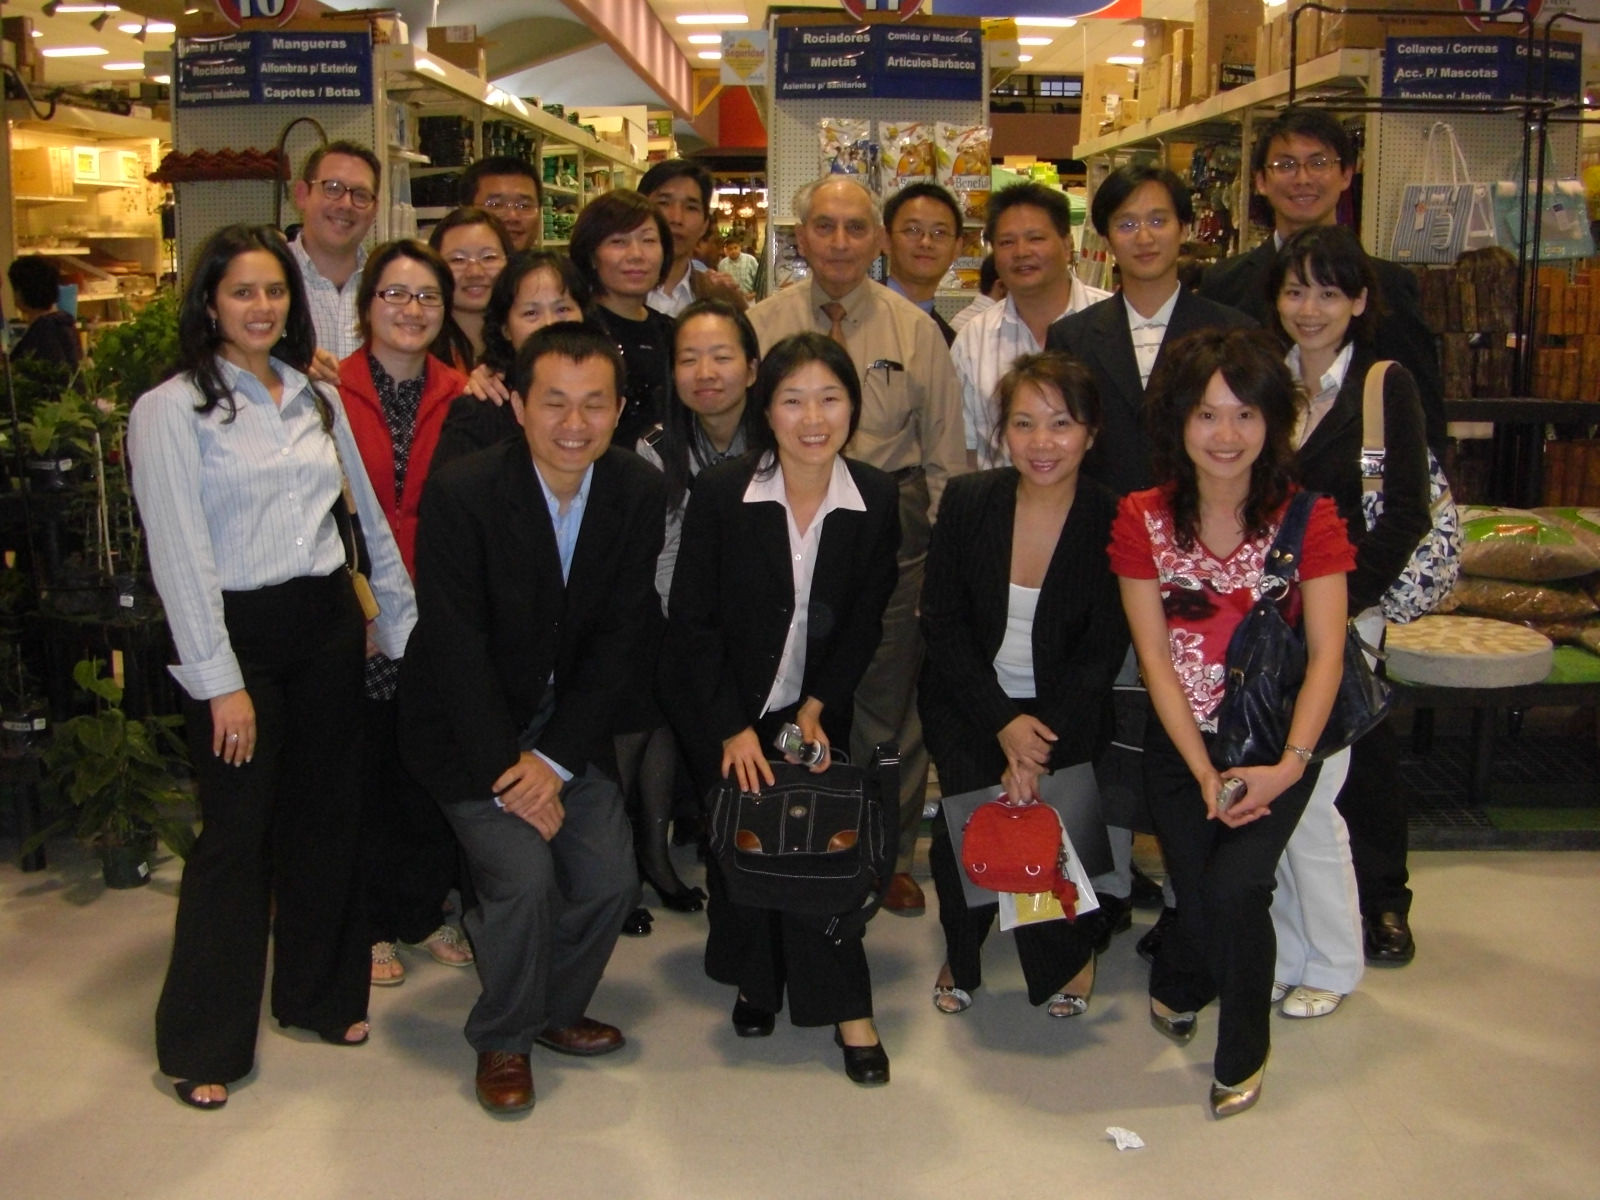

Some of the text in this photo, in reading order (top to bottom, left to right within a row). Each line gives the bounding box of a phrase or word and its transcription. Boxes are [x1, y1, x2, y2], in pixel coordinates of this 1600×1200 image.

[803, 33, 871, 44] Rociadores
[887, 32, 973, 43] Comida p/ Mascotas
[272, 38, 347, 51] Mangueras
[1397, 43, 1499, 54] Collares / Correas
[724, 48, 765, 58] Seguridad
[810, 57, 857, 68] Maletas
[192, 65, 246, 76] Rociadores
[260, 63, 358, 75] Alfombras p/ Exterior
[1425, 68, 1438, 78] P/
[1440, 68, 1498, 78] Mascotas
[783, 81, 867, 91] Asientos p/ Sanitarios
[263, 86, 316, 100] Capotes
[325, 86, 361, 98] Botas
